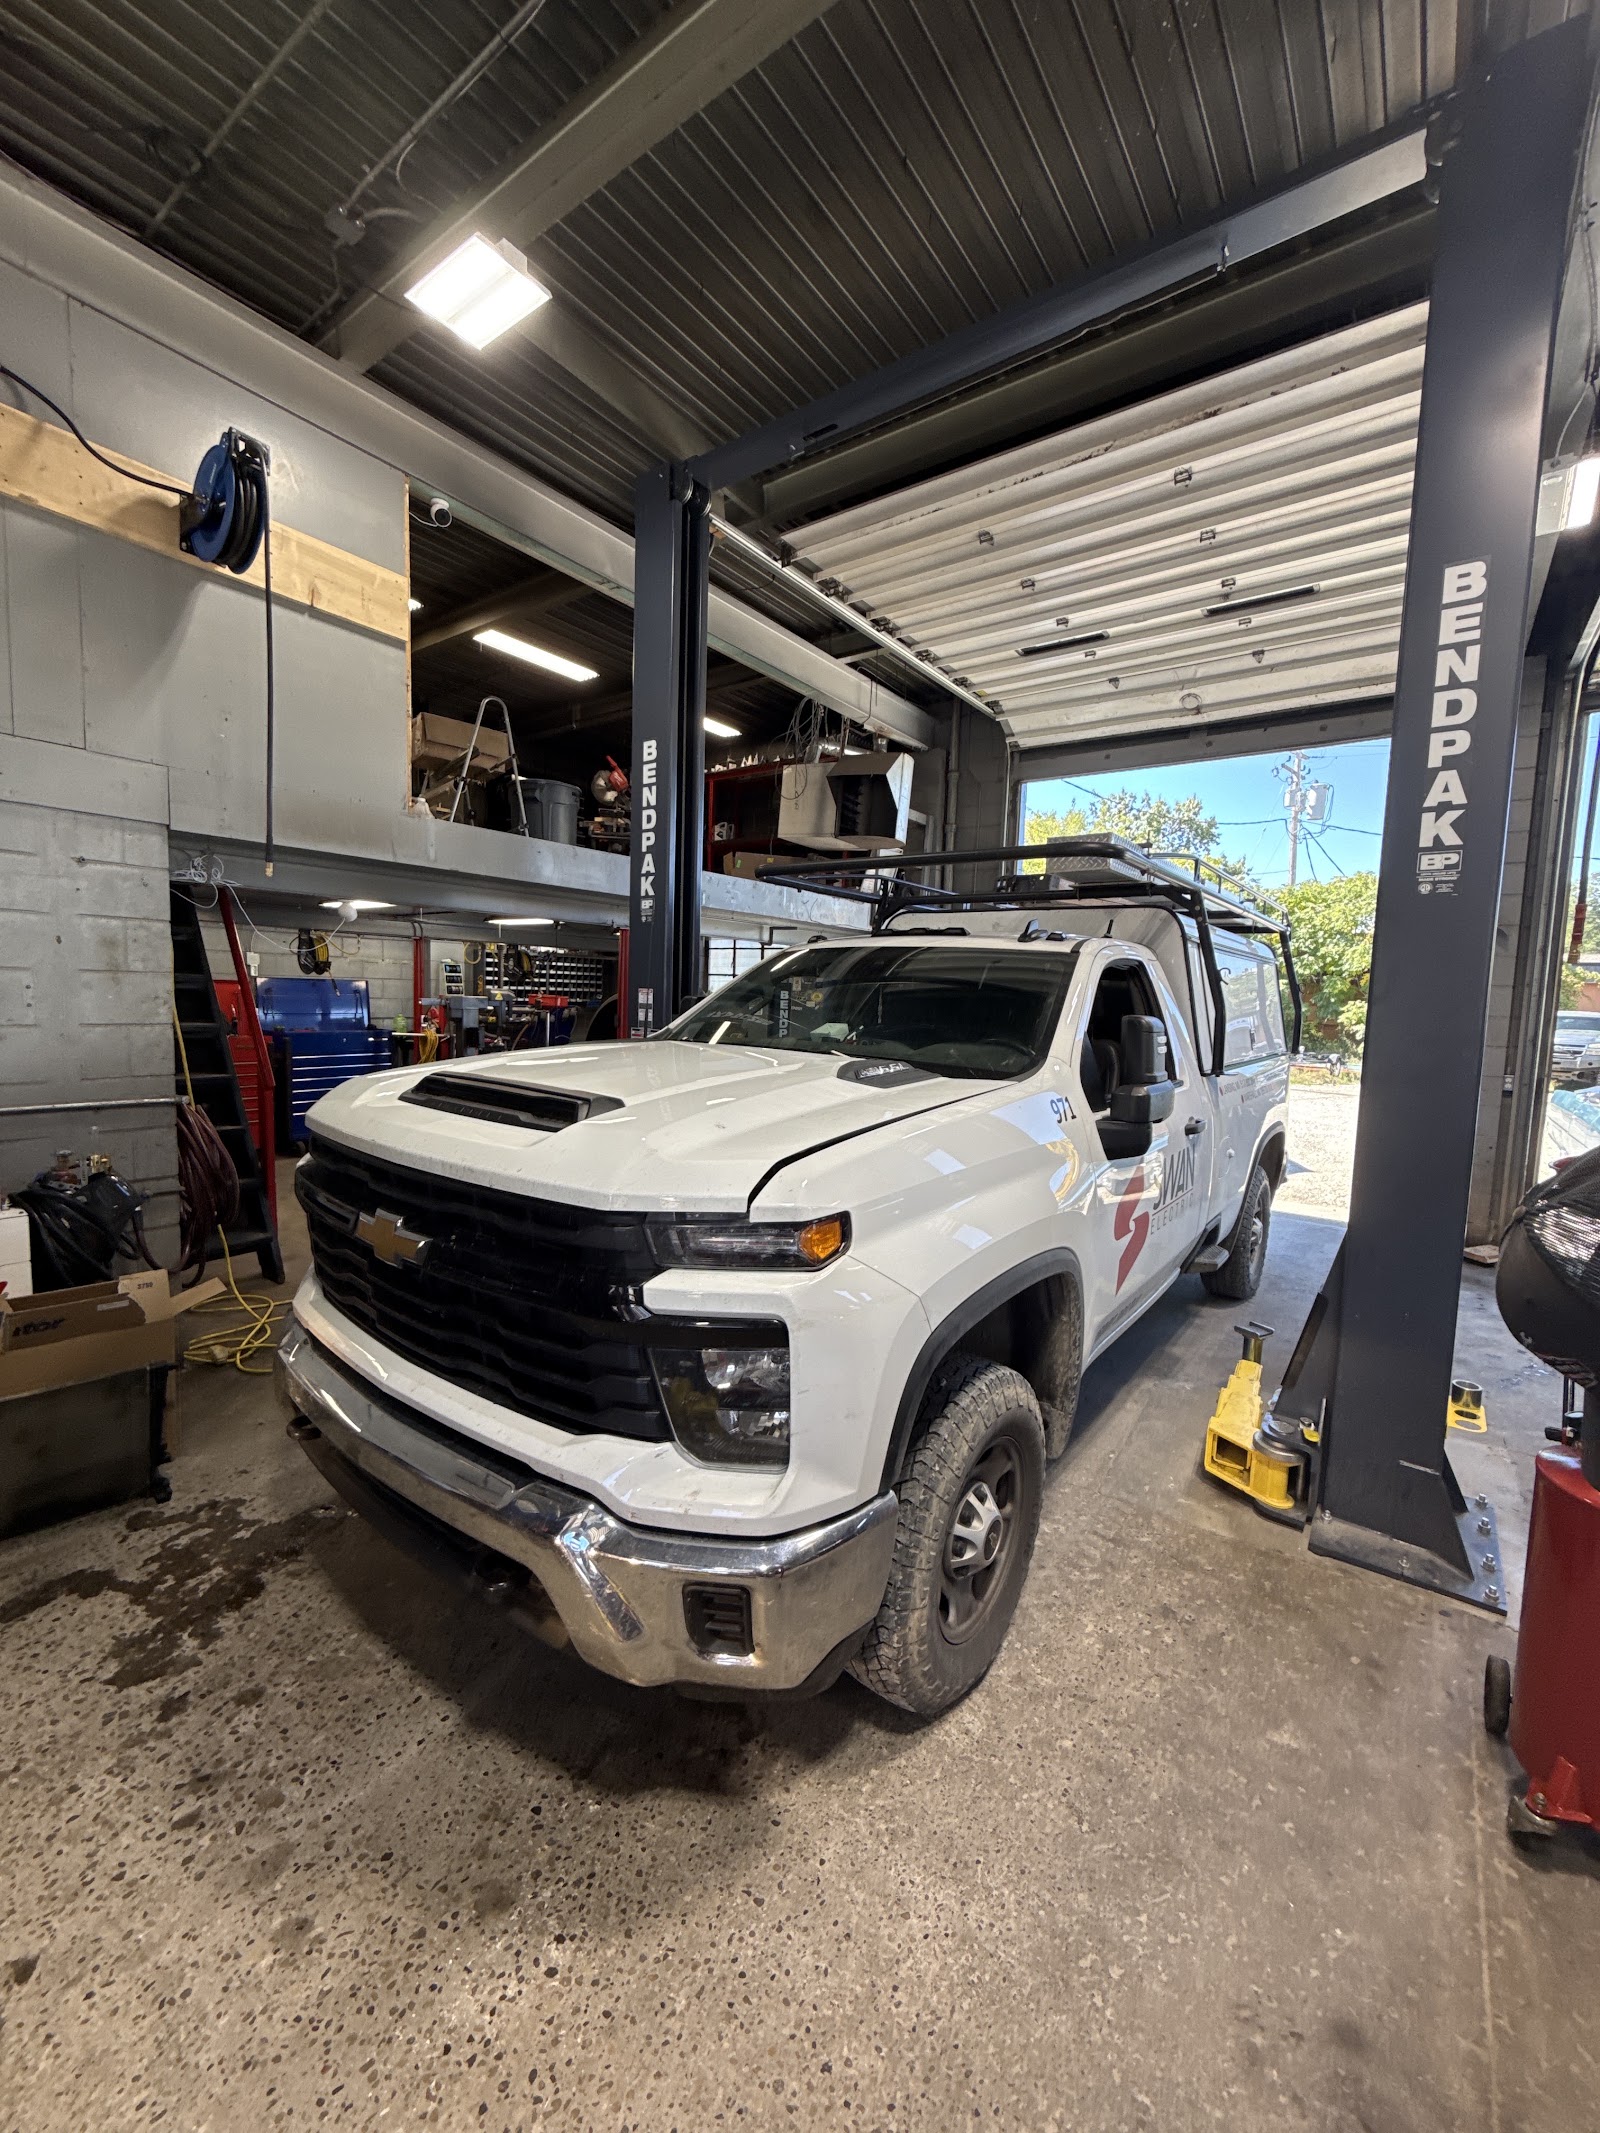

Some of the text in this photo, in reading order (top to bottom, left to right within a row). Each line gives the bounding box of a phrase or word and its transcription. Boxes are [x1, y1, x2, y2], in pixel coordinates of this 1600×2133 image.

[1418, 560, 1488, 848] BENDPAK
[640, 739, 658, 897] BENDPAK
[1420, 853, 1460, 870] BP
[1050, 1096, 1077, 1124] 971
[1150, 1193, 1194, 1235] ELECTRIC
